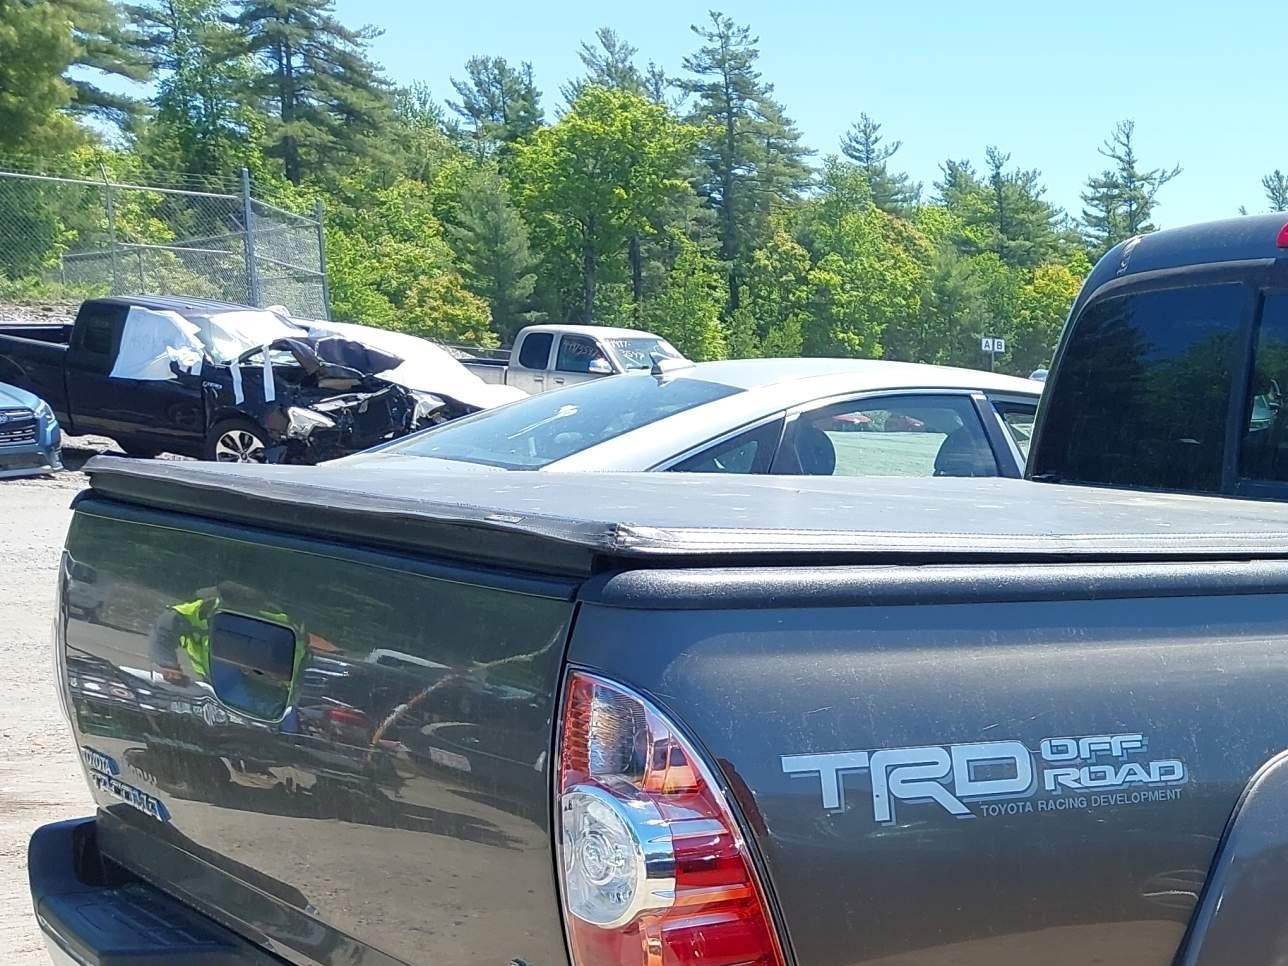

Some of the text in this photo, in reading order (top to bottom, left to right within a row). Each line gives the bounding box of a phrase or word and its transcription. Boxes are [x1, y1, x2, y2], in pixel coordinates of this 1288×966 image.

[1040, 734, 1147, 761] OFF
[780, 740, 1035, 824] TRD
[1044, 758, 1187, 791] ROAD
[981, 788, 1183, 817] TOYOTA RACING DEVELOPMENT
